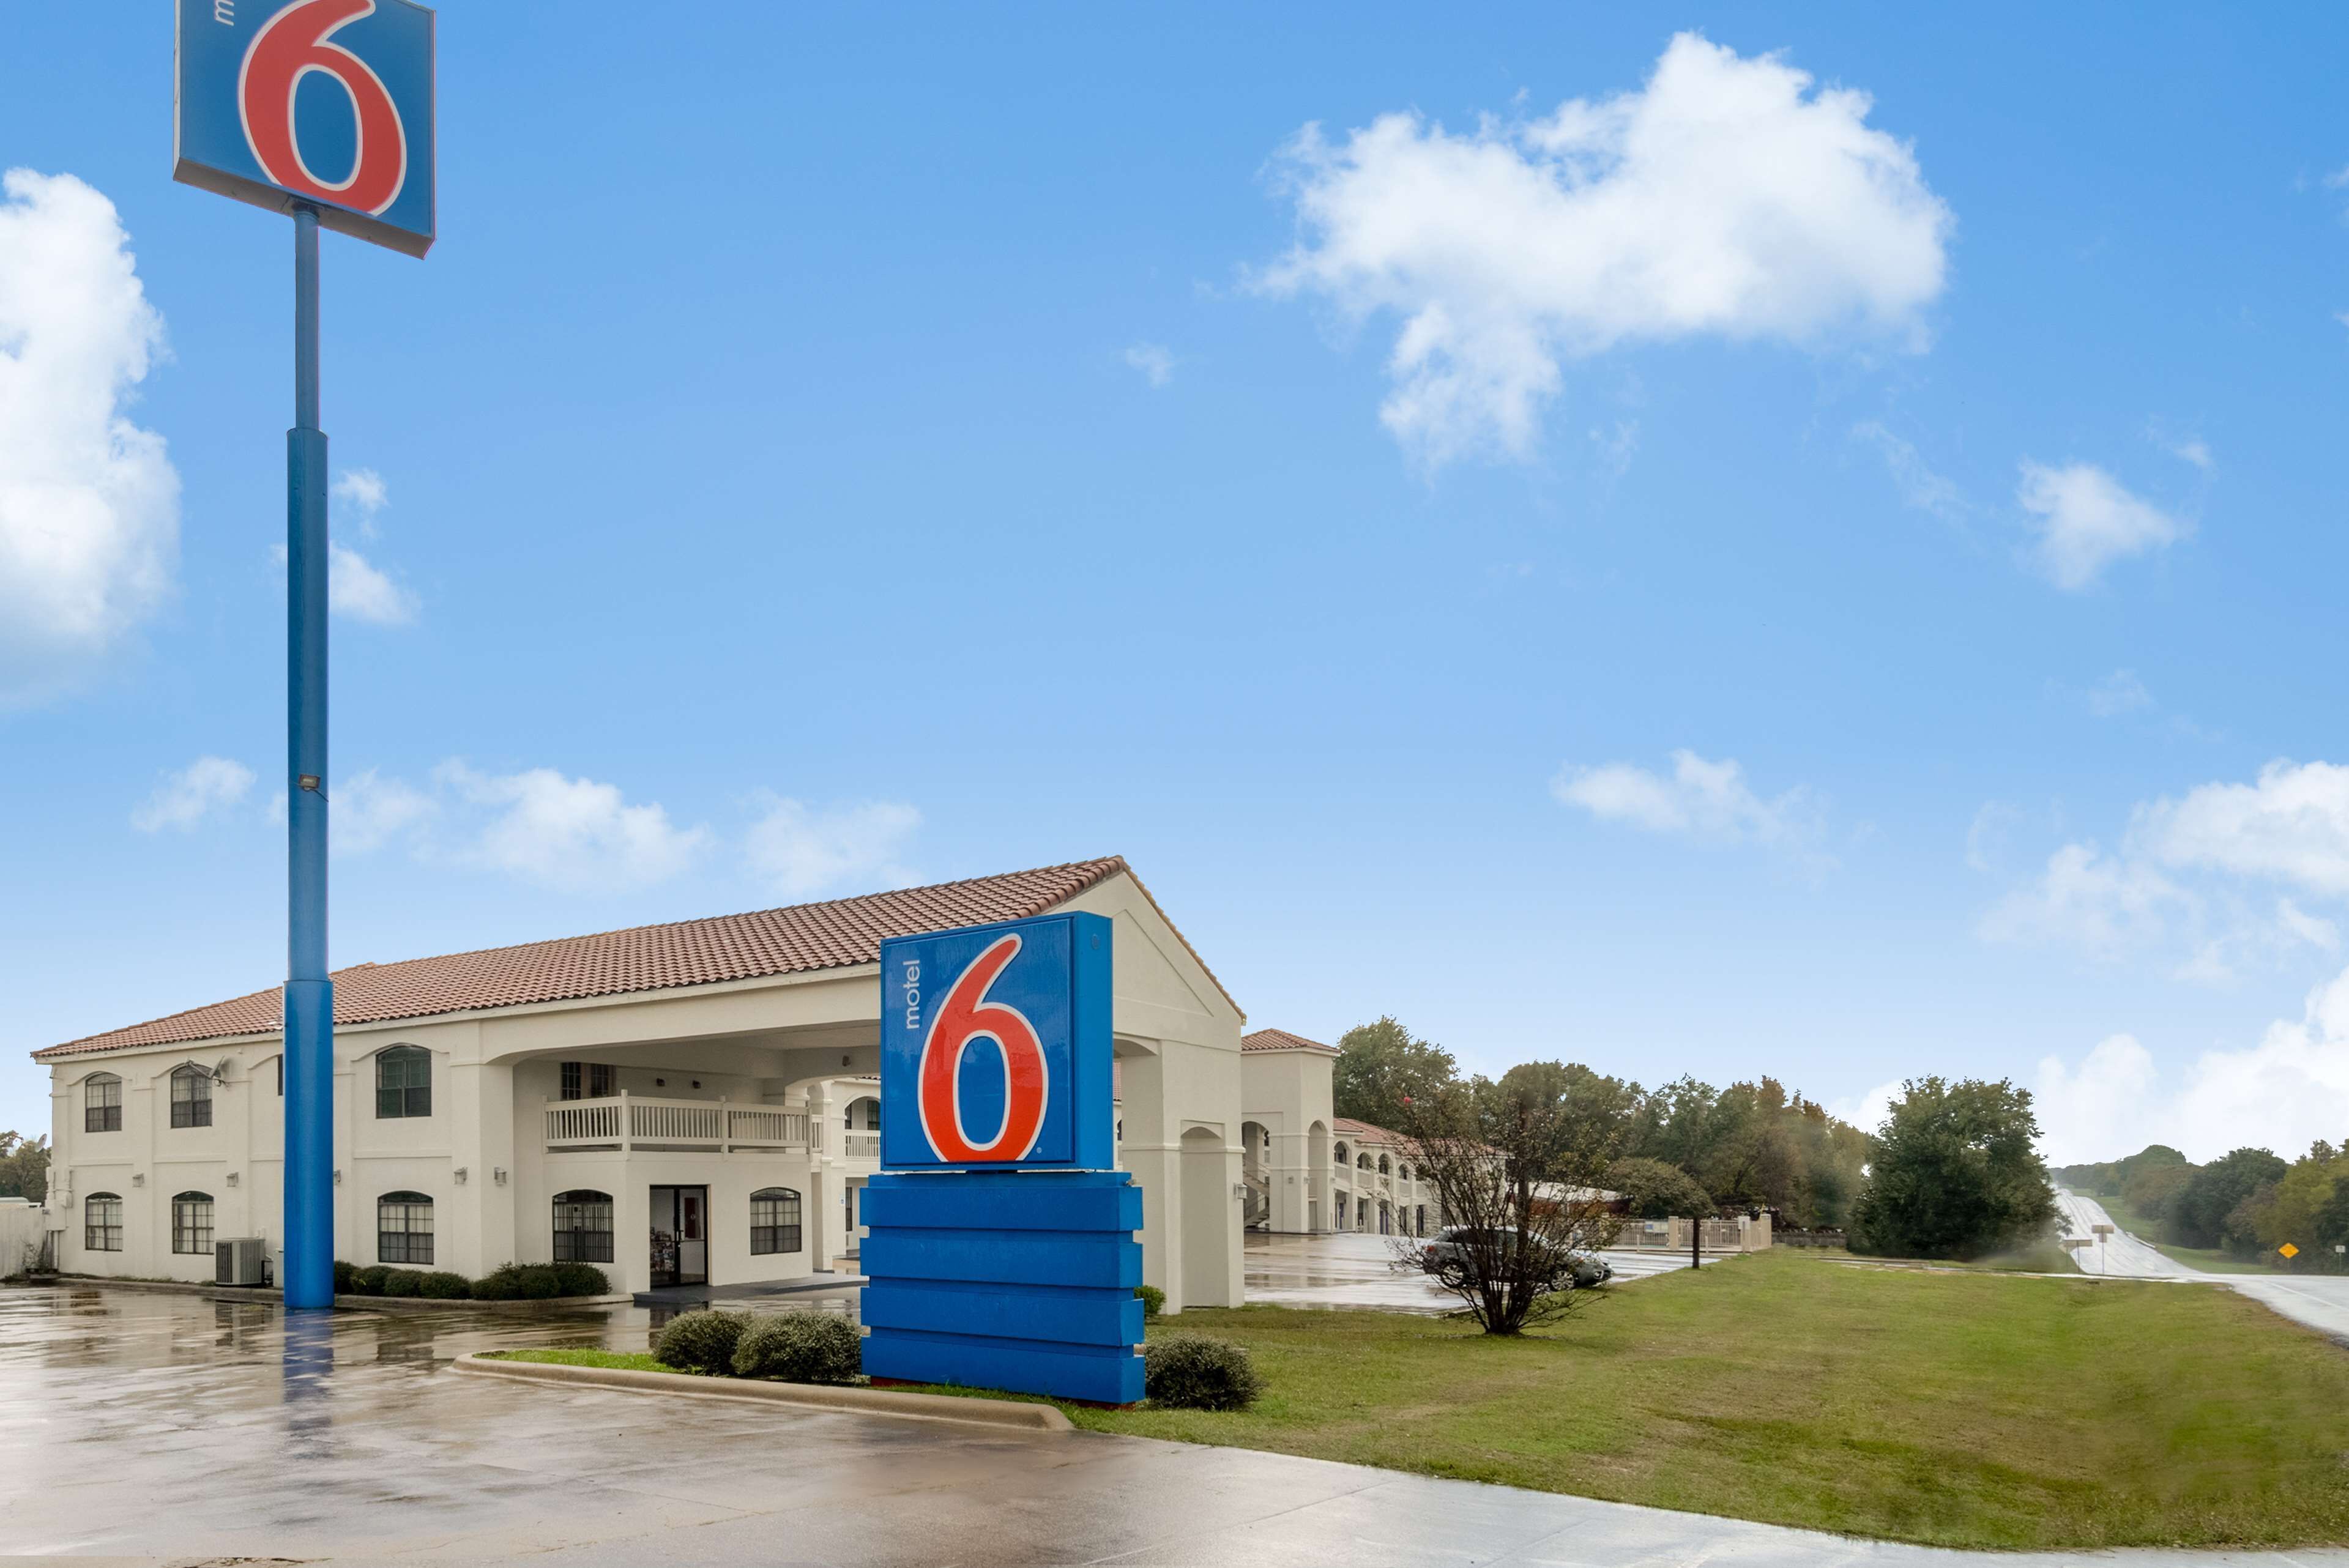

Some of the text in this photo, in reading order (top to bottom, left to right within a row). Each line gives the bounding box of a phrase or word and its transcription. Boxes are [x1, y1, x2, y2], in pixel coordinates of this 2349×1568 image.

[237, 0, 407, 216] 6
[903, 959, 920, 1028] motel
[918, 932, 1049, 1162] 6
